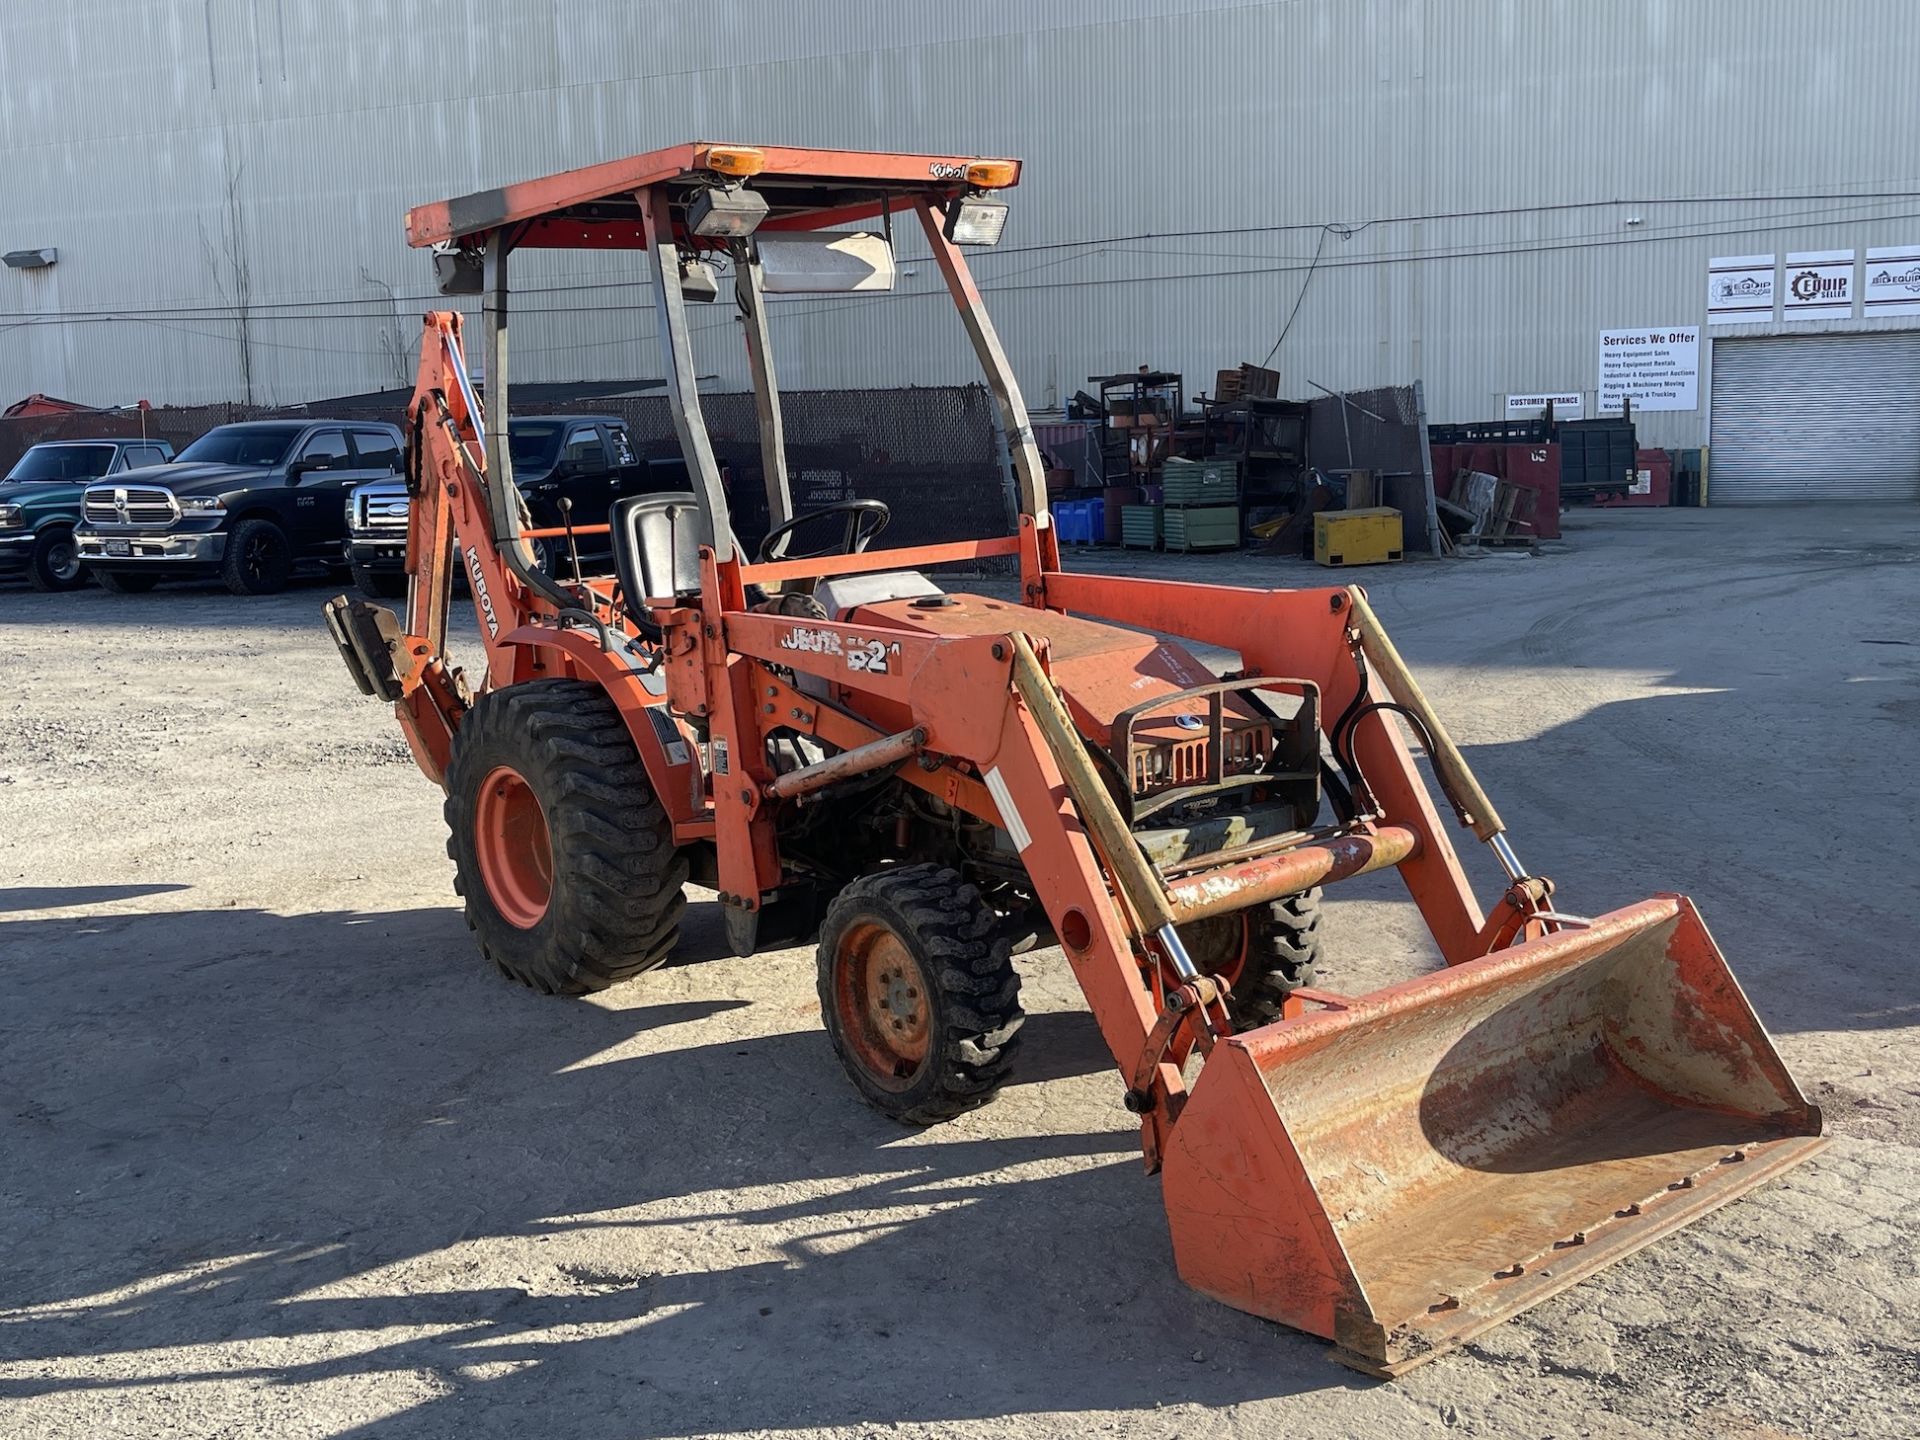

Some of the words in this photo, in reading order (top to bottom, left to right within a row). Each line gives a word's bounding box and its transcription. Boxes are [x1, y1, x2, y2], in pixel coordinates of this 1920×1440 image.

[1803, 278, 1847, 293] EQUIP
[1821, 290, 1847, 298] SELLER
[1603, 335, 1647, 346] Services
[1649, 334, 1665, 344] We
[1669, 333, 1695, 344] Offer
[1510, 398, 1545, 406] CUSTOMER
[1547, 397, 1578, 405] TRANCE
[465, 544, 499, 640] KUBOTA
